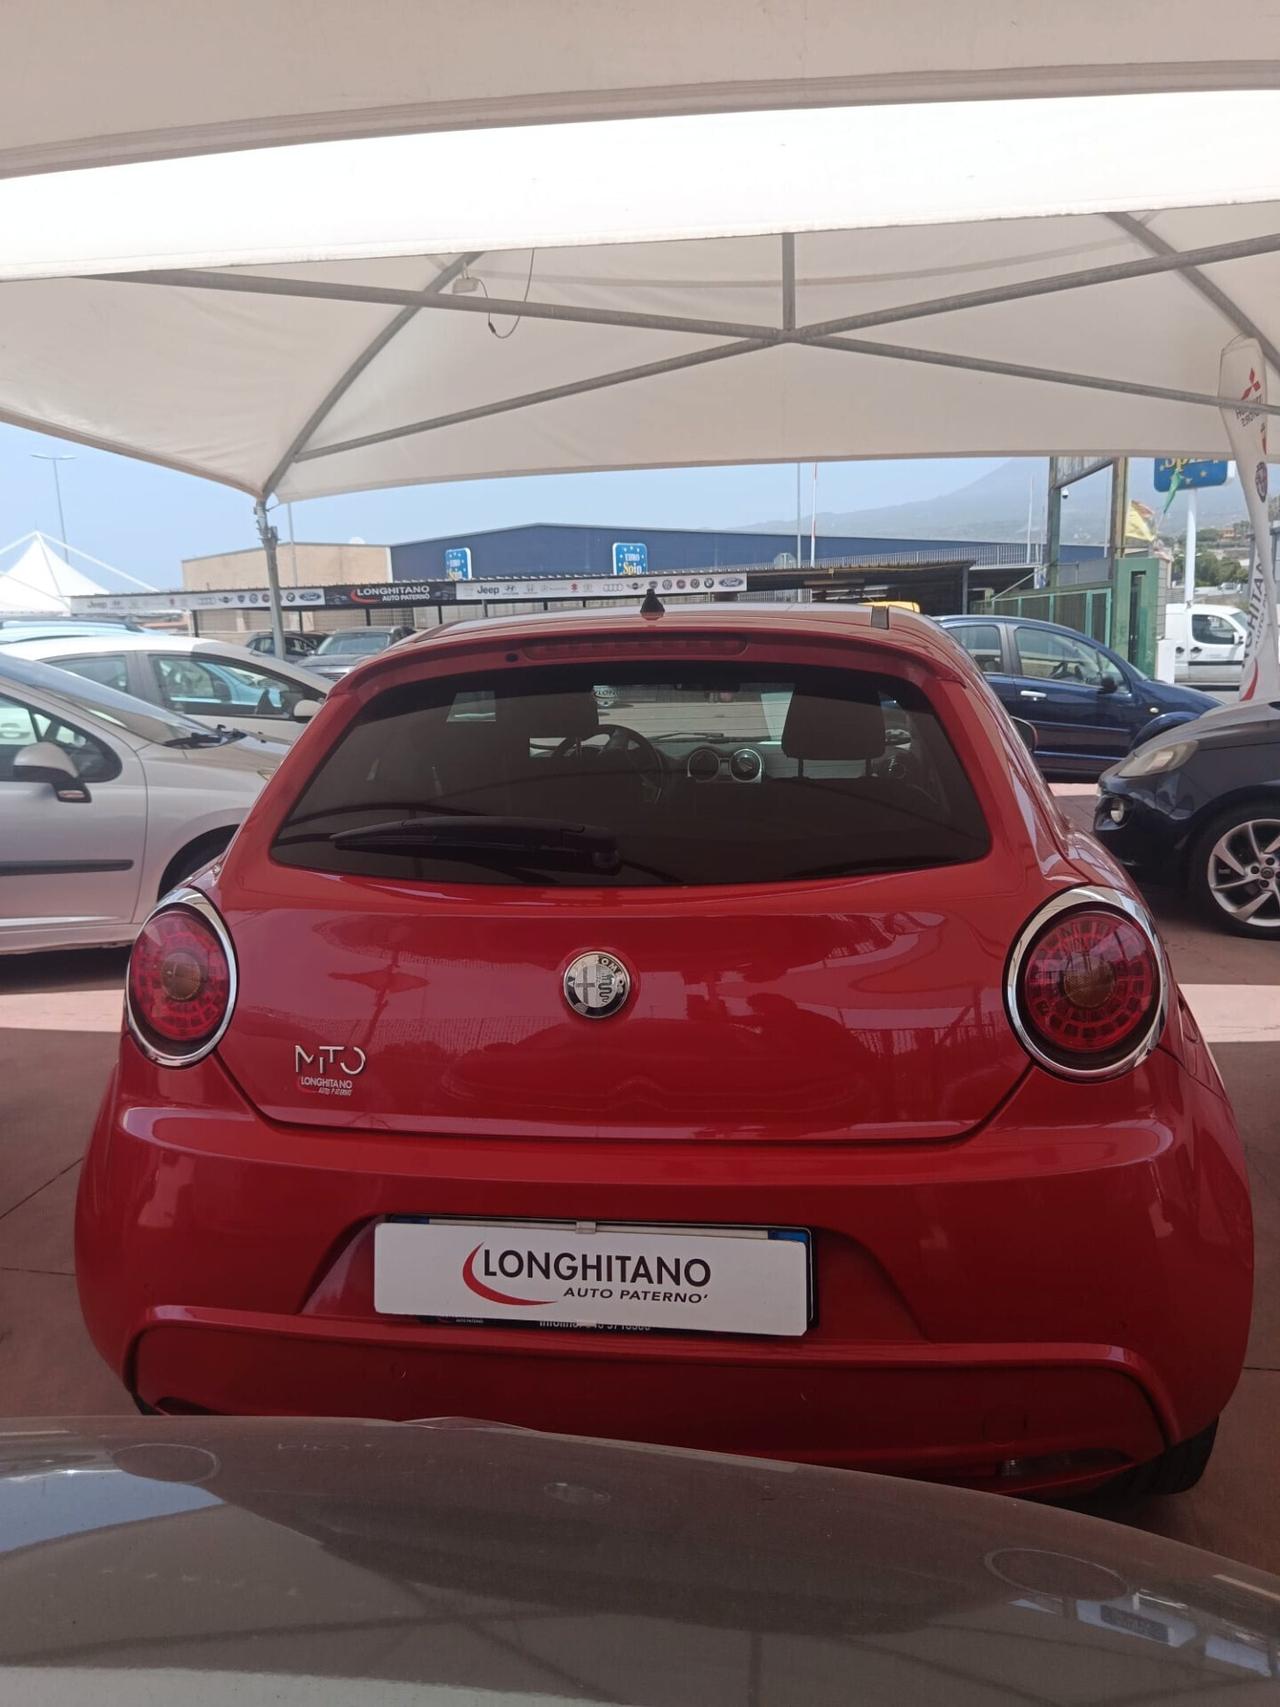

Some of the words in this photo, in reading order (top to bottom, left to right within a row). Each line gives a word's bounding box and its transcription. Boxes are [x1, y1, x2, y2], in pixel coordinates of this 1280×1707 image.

[356, 585, 430, 596] LONGHITANO
[476, 585, 500, 596] Jeep
[382, 594, 400, 602] AUTO
[300, 1076, 352, 1089] LONGHITANO
[483, 1249, 712, 1287] LONGHITANO
[563, 1287, 613, 1299] AUTO
